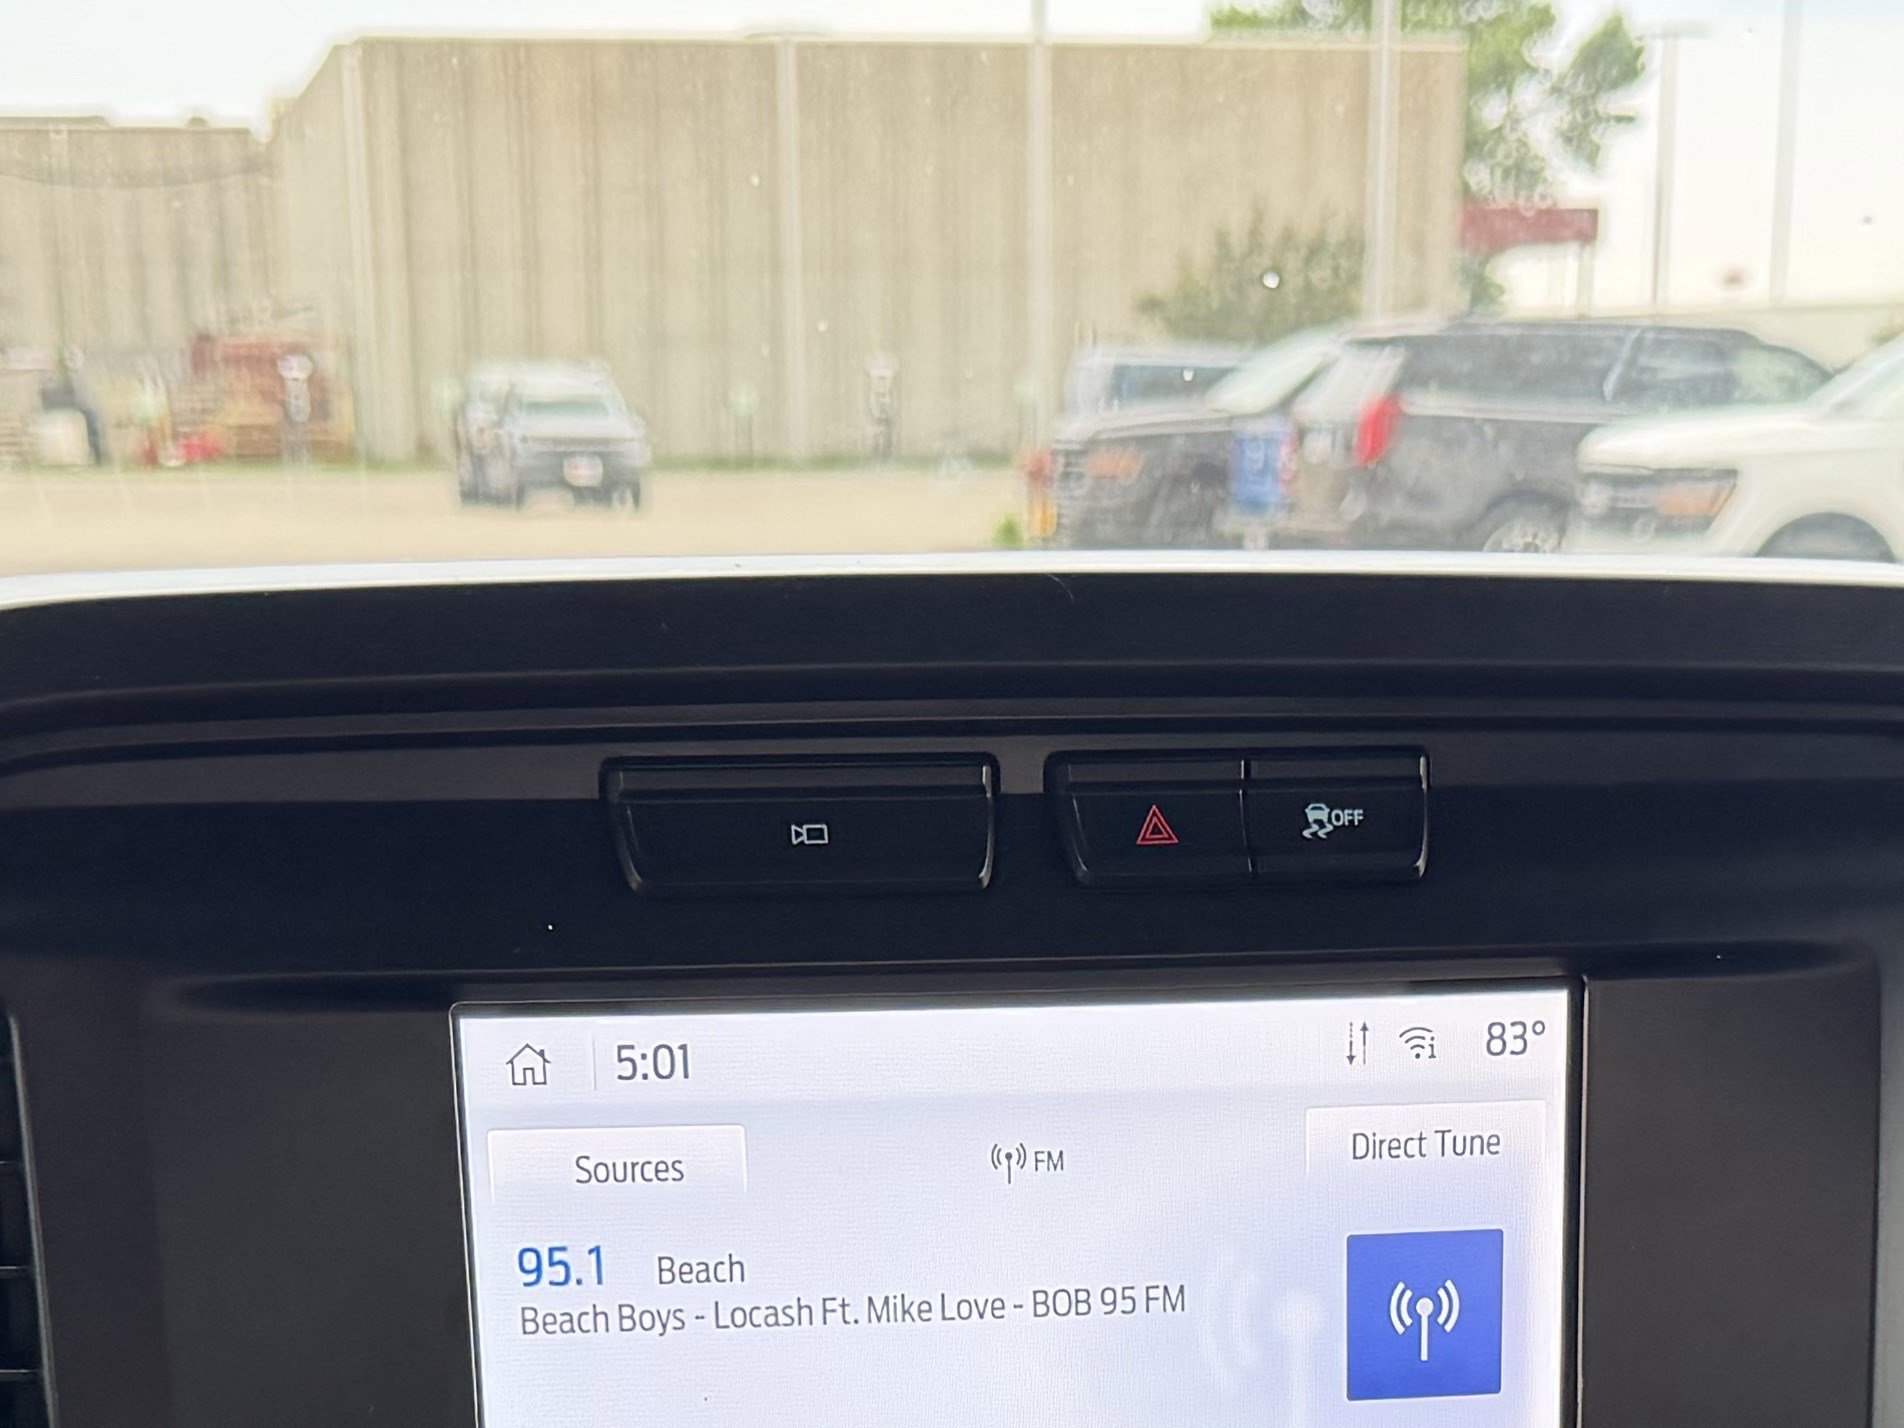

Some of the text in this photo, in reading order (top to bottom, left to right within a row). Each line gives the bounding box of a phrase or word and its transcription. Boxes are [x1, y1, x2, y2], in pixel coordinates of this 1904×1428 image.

[1331, 809, 1364, 826] OFF
[1485, 1019, 1546, 1057] 83°
[616, 1043, 690, 1081] 5:01
[1033, 1149, 1064, 1172] FM
[1352, 1128, 1501, 1161] Direct Tune
[575, 1155, 685, 1185] Sources
[517, 1244, 603, 1288] 95.1
[657, 1252, 745, 1285] Beach
[520, 1303, 610, 1336] Beach
[617, 1303, 686, 1338] Boys
[714, 1295, 814, 1330] Locash
[821, 1296, 860, 1326] Ft.
[867, 1292, 933, 1324] Mike
[940, 1292, 1006, 1322] Love
[1032, 1288, 1092, 1318] BOB
[1100, 1285, 1137, 1316] 95
[1145, 1284, 1186, 1314] FM
